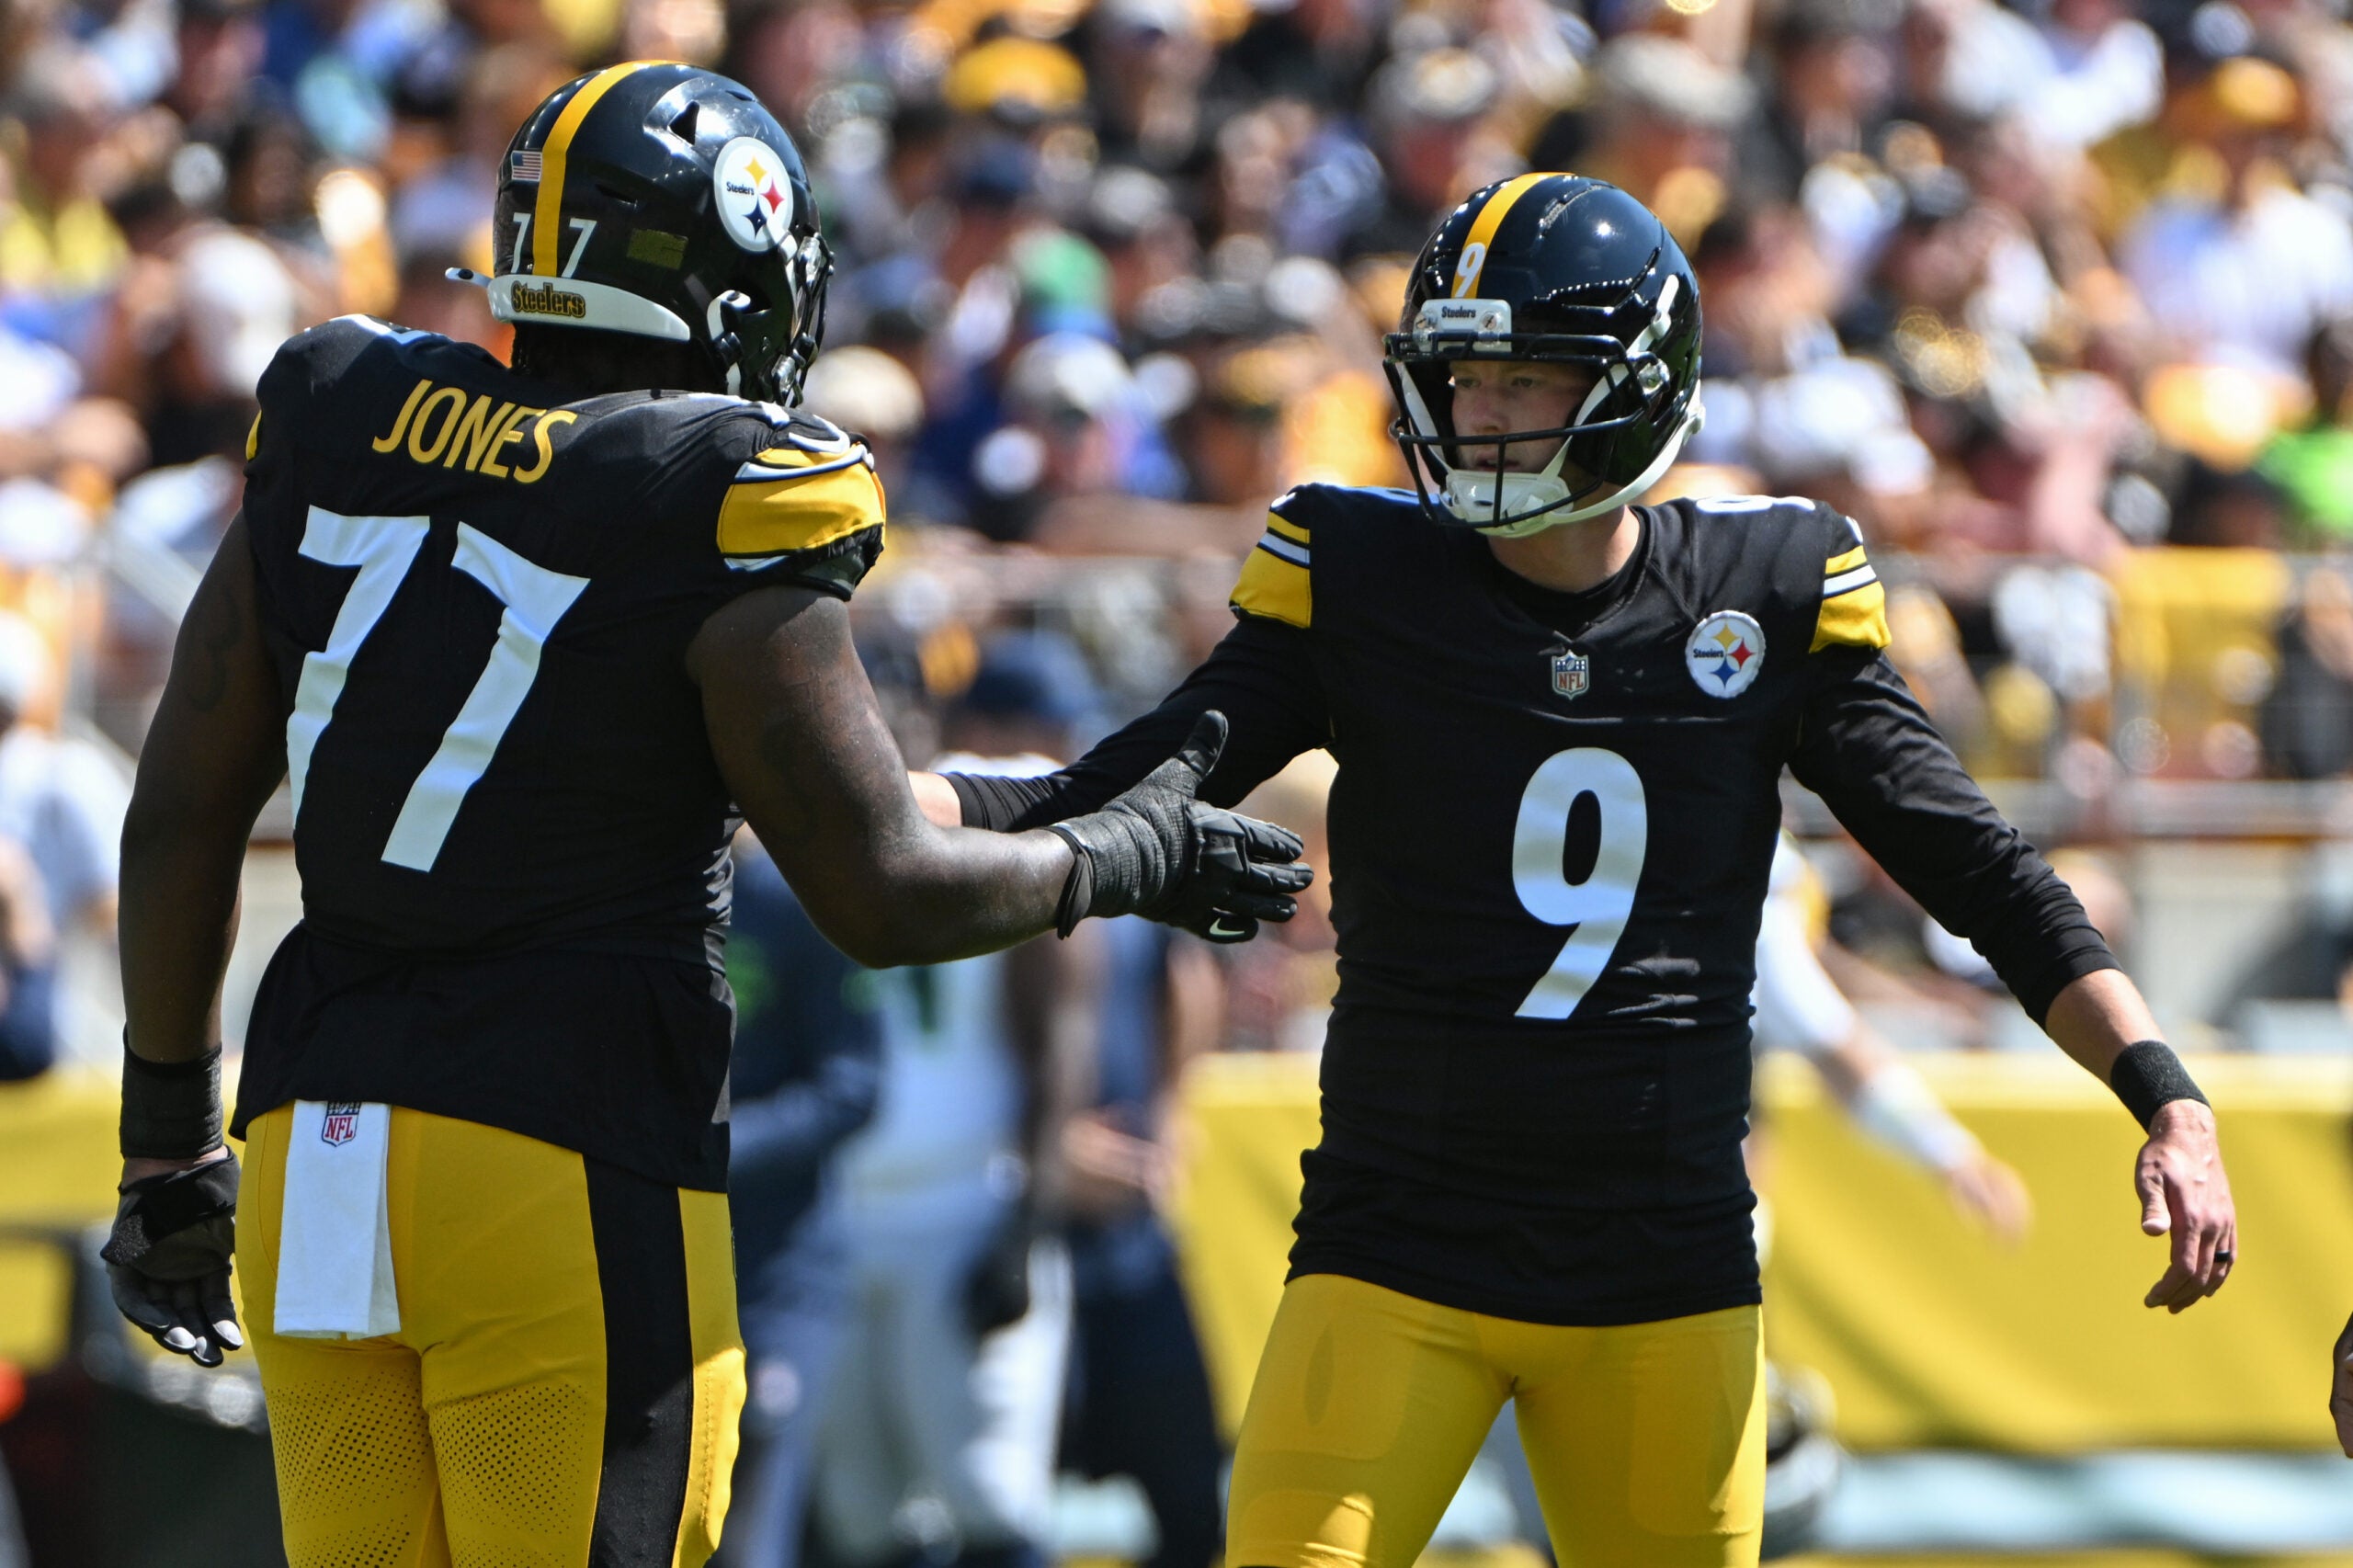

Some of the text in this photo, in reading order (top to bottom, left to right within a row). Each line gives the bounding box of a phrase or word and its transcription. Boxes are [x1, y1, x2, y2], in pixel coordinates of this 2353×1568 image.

[726, 180, 755, 196] Steelers
[1457, 242, 1486, 299] 9
[511, 280, 586, 318] Steelers
[1441, 305, 1476, 318] Steelers
[371, 379, 578, 483] JONES
[1693, 647, 1724, 658] Steelers
[286, 505, 591, 873] 77
[1558, 672, 1584, 690] NFL
[1512, 747, 1648, 1019] 9
[324, 1116, 354, 1142] NFL
